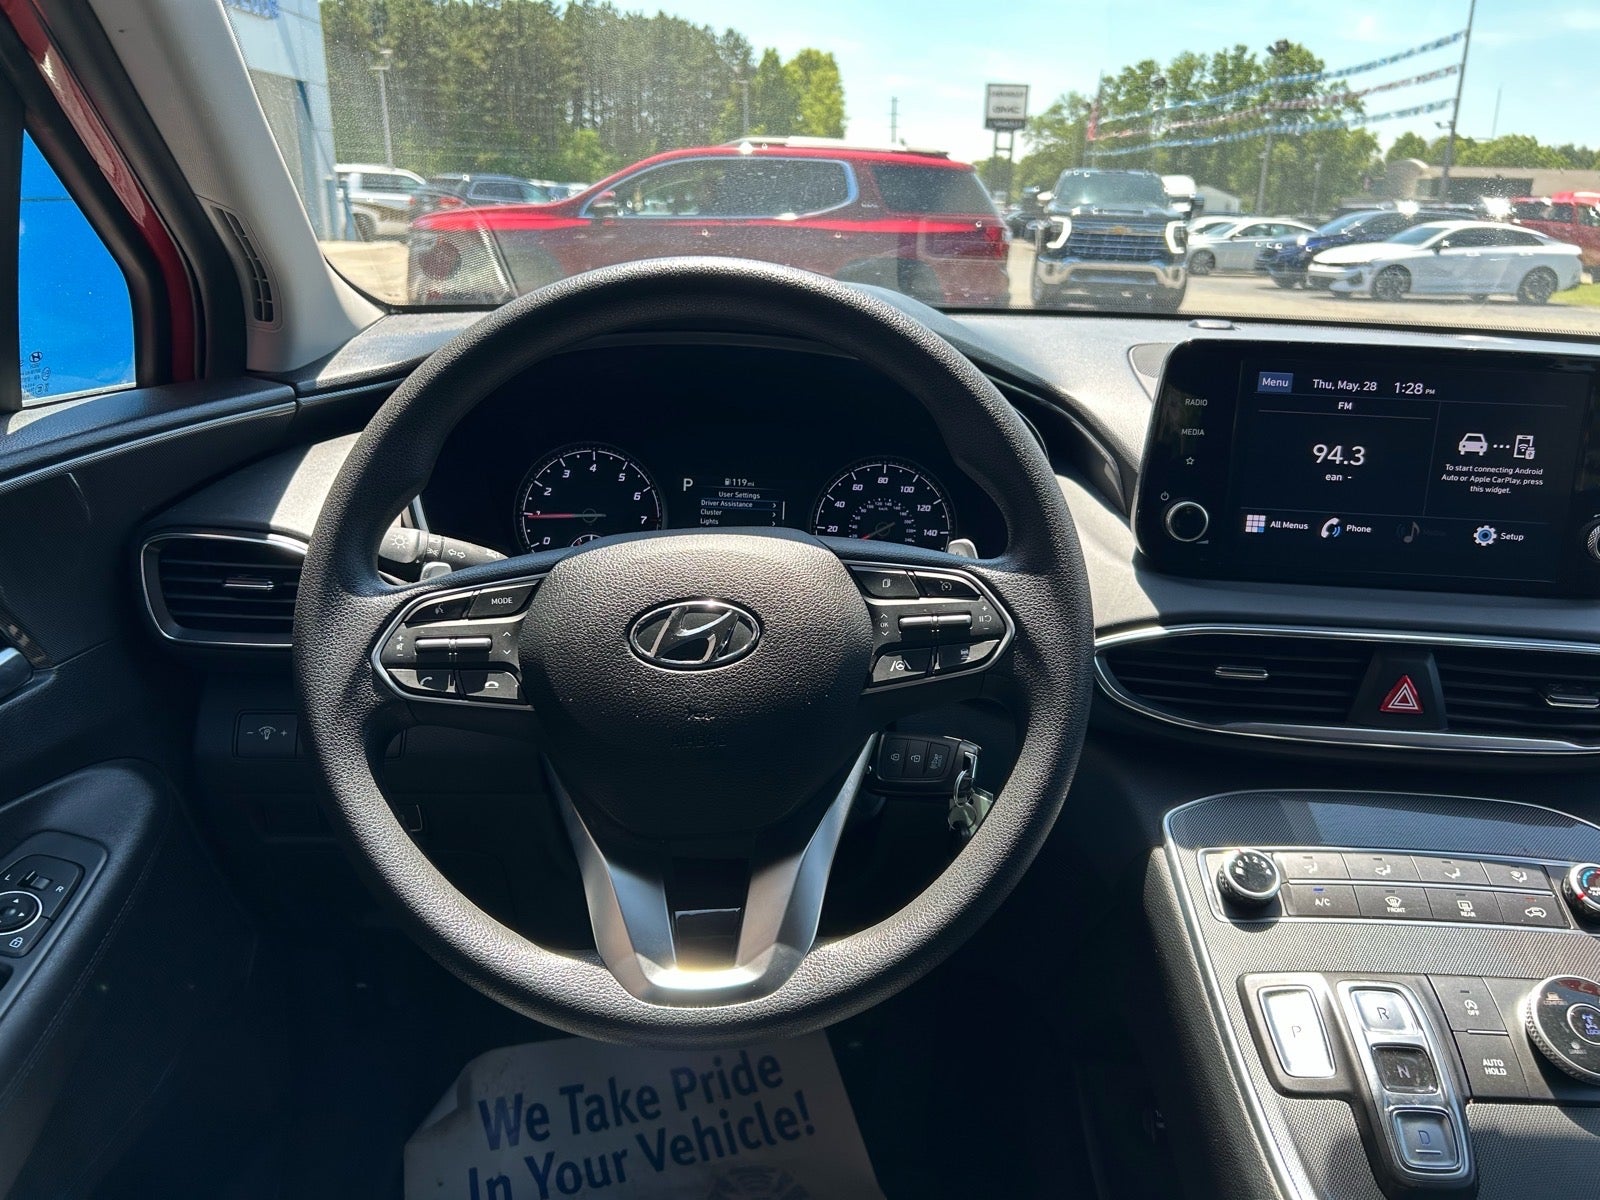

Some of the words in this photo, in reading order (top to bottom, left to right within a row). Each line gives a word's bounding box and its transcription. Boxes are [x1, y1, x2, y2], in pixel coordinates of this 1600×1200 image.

[1262, 377, 1289, 387] Menu
[1312, 379, 1336, 390] Thu,
[1338, 380, 1361, 391] May.
[1363, 381, 1378, 391] 28
[1394, 382, 1423, 395] 1:28
[1185, 398, 1208, 407] RADIO
[1338, 402, 1352, 410] FM
[1181, 428, 1205, 436] MEDIA
[1312, 443, 1366, 466] 94.3
[589, 463, 597, 473] 4
[1445, 463, 1454, 471] To
[1455, 464, 1473, 472] start
[1474, 465, 1514, 475] connecting
[1514, 467, 1543, 475] Android
[562, 469, 571, 479] 3
[618, 472, 626, 482] 5
[1325, 473, 1343, 482] ean
[877, 476, 889, 484] 80
[1441, 474, 1459, 482] Auto
[1469, 475, 1491, 484] Apple
[1523, 478, 1544, 486] press
[683, 478, 694, 492] P
[1470, 485, 1484, 493] this
[1485, 486, 1511, 494] widget.
[544, 487, 552, 496] 2
[735, 491, 761, 500] Settings
[633, 492, 641, 501] 6
[701, 499, 720, 507] Driver
[720, 500, 753, 508] Assistance
[917, 504, 932, 512] 120
[640, 515, 648, 525] 7
[700, 517, 719, 526] Lights
[827, 525, 838, 533] 20
[1270, 520, 1282, 529] All
[1283, 521, 1309, 530] Menus
[1346, 524, 1372, 534] Phone
[923, 529, 938, 537] 140
[1500, 532, 1524, 542] Setup
[543, 536, 551, 545] 0
[491, 597, 513, 605] MODE
[55, 885, 64, 893] R
[1314, 898, 1331, 907] A/C
[1377, 1007, 1390, 1021] R
[1291, 1025, 1302, 1038] P
[1482, 1058, 1504, 1067] AUTO
[1397, 1064, 1410, 1078] N
[1485, 1067, 1507, 1076] HOLD
[478, 1091, 551, 1151] We
[559, 1077, 662, 1136] Take
[670, 1050, 784, 1110] Pride
[1417, 1130, 1431, 1145] D
[468, 1166, 513, 1200] In
[524, 1147, 628, 1200] Your
[635, 1090, 816, 1173] Vehicle!
